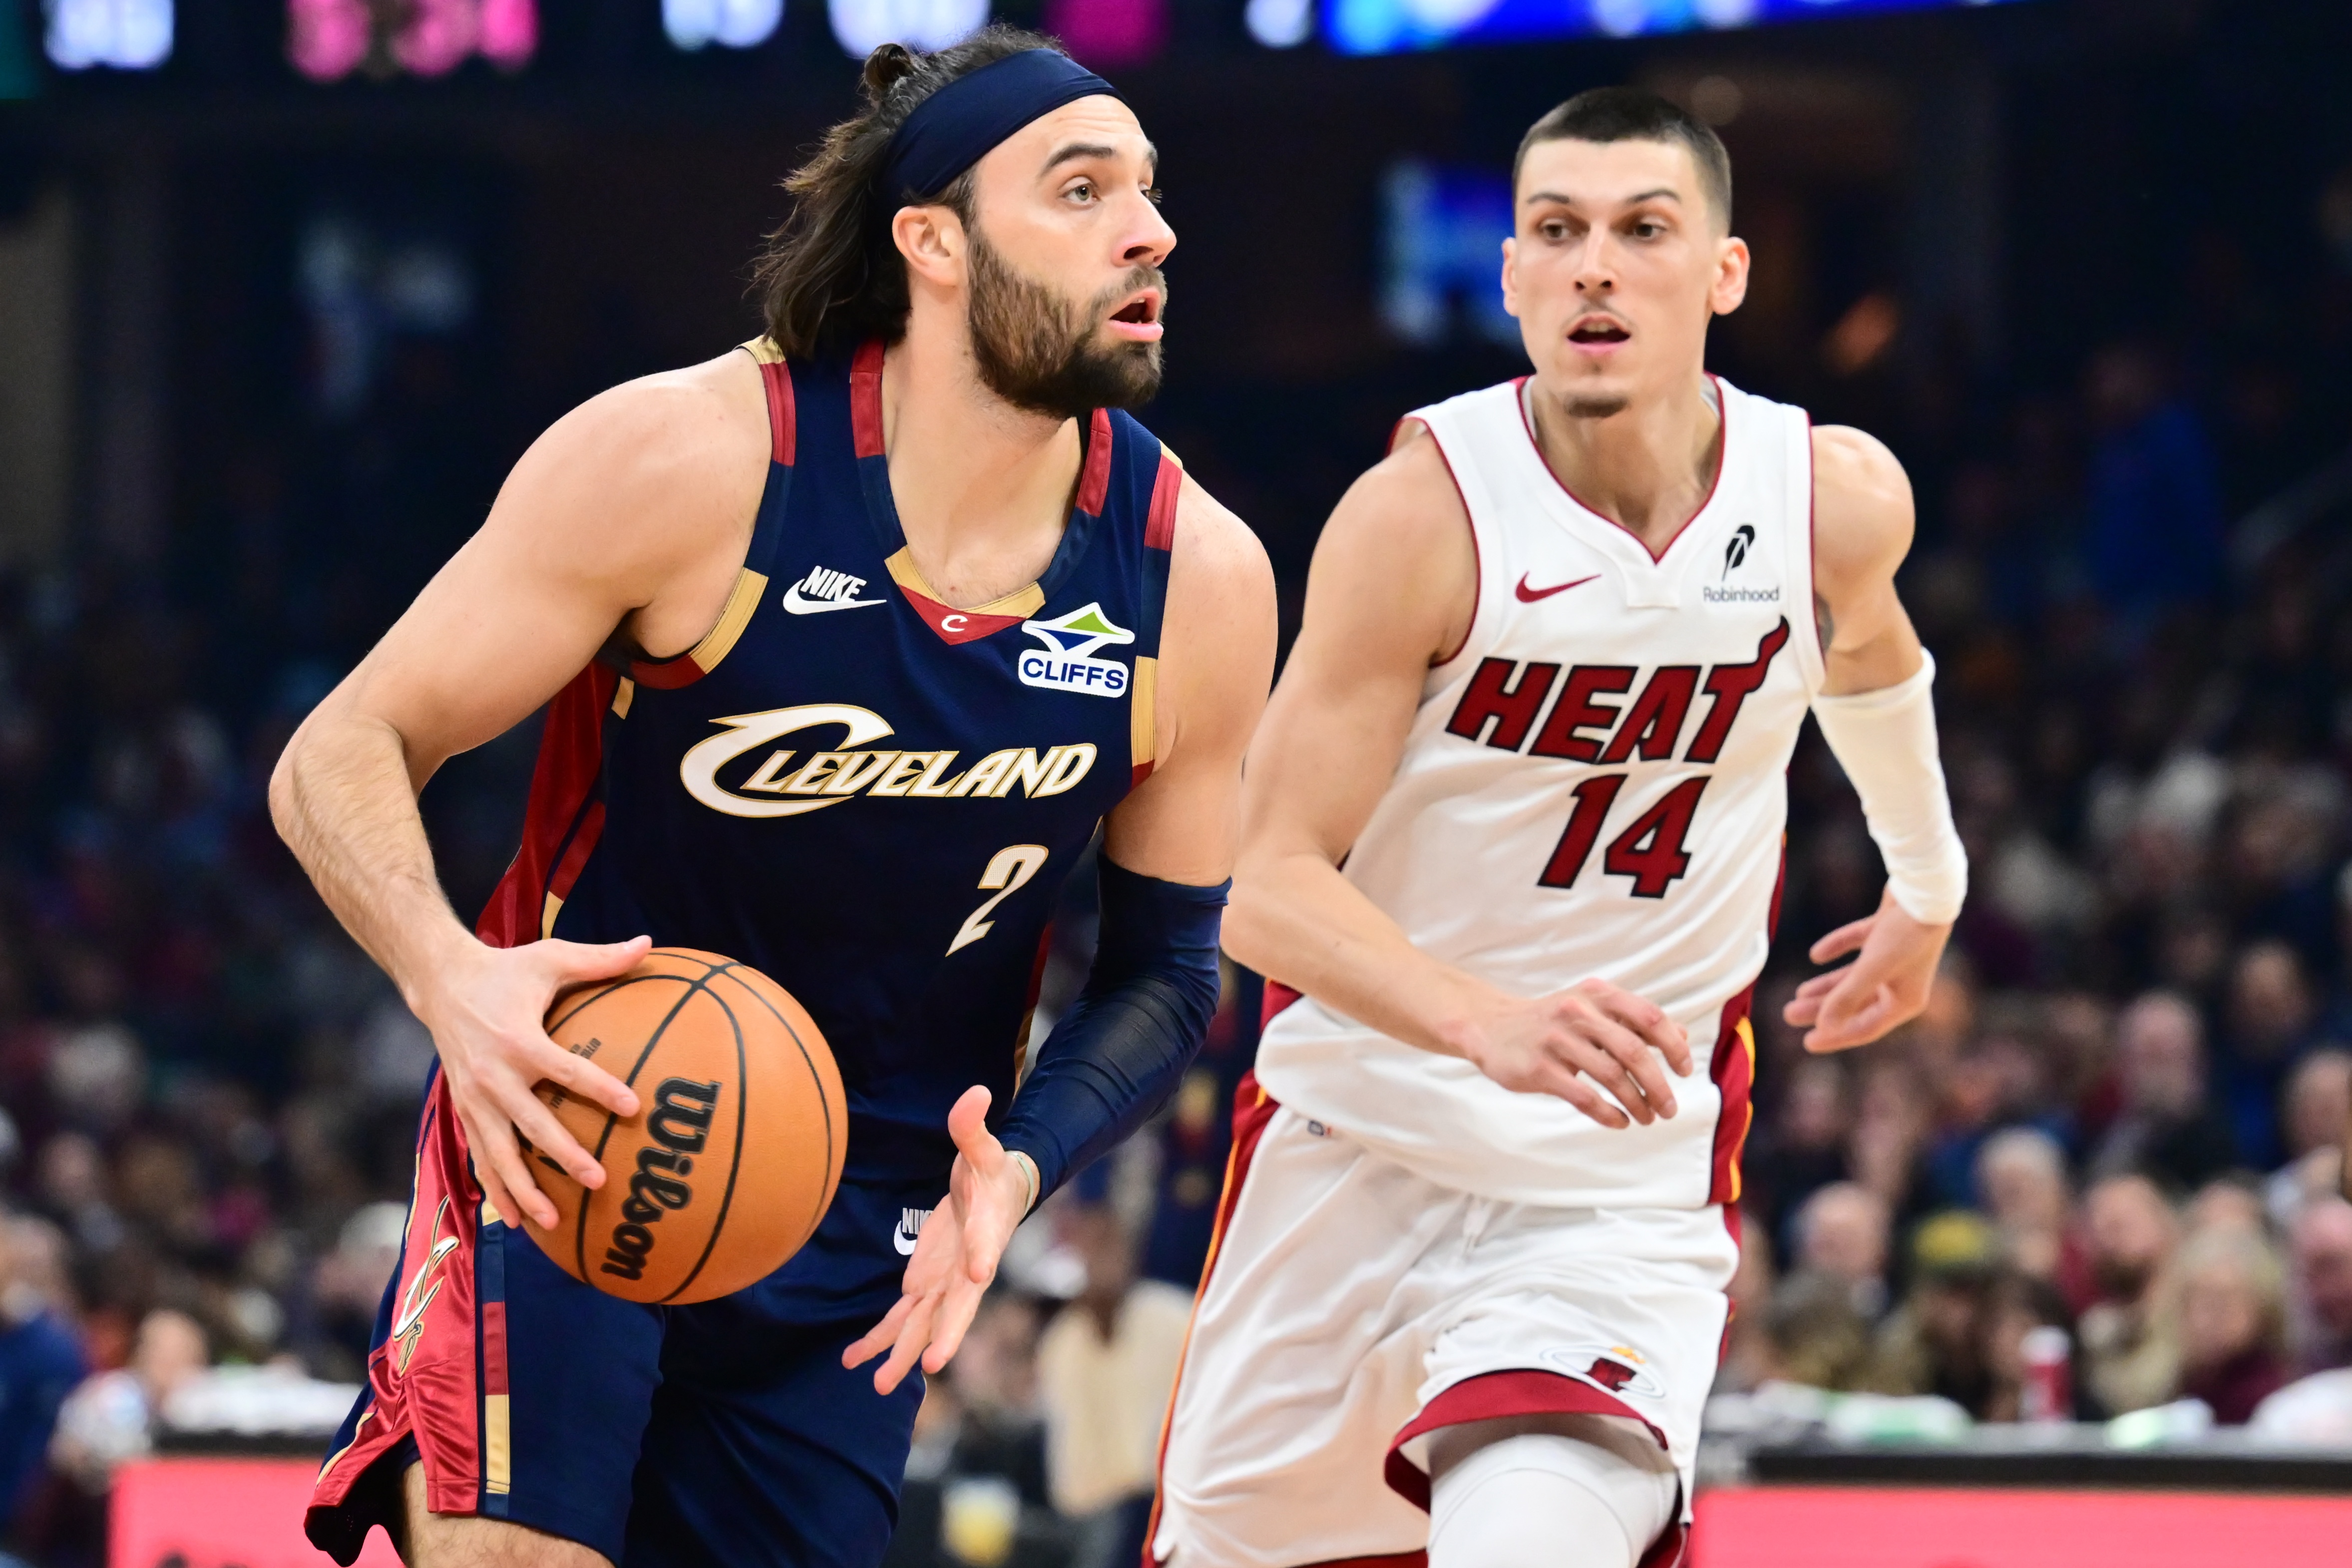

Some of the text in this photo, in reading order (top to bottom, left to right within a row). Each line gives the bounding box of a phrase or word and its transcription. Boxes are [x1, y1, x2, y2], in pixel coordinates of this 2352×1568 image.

[800, 565, 867, 602] NIKE
[1703, 586, 1780, 602] Robinhood
[1023, 658, 1124, 689] CLIFFS
[1445, 614, 1790, 765] HEAT
[680, 703, 1097, 817] CLEVELAND
[1536, 773, 1712, 899] 14
[945, 844, 1048, 957] 2
[601, 1077, 722, 1280] Wilson
[902, 1207, 934, 1234] NIK
